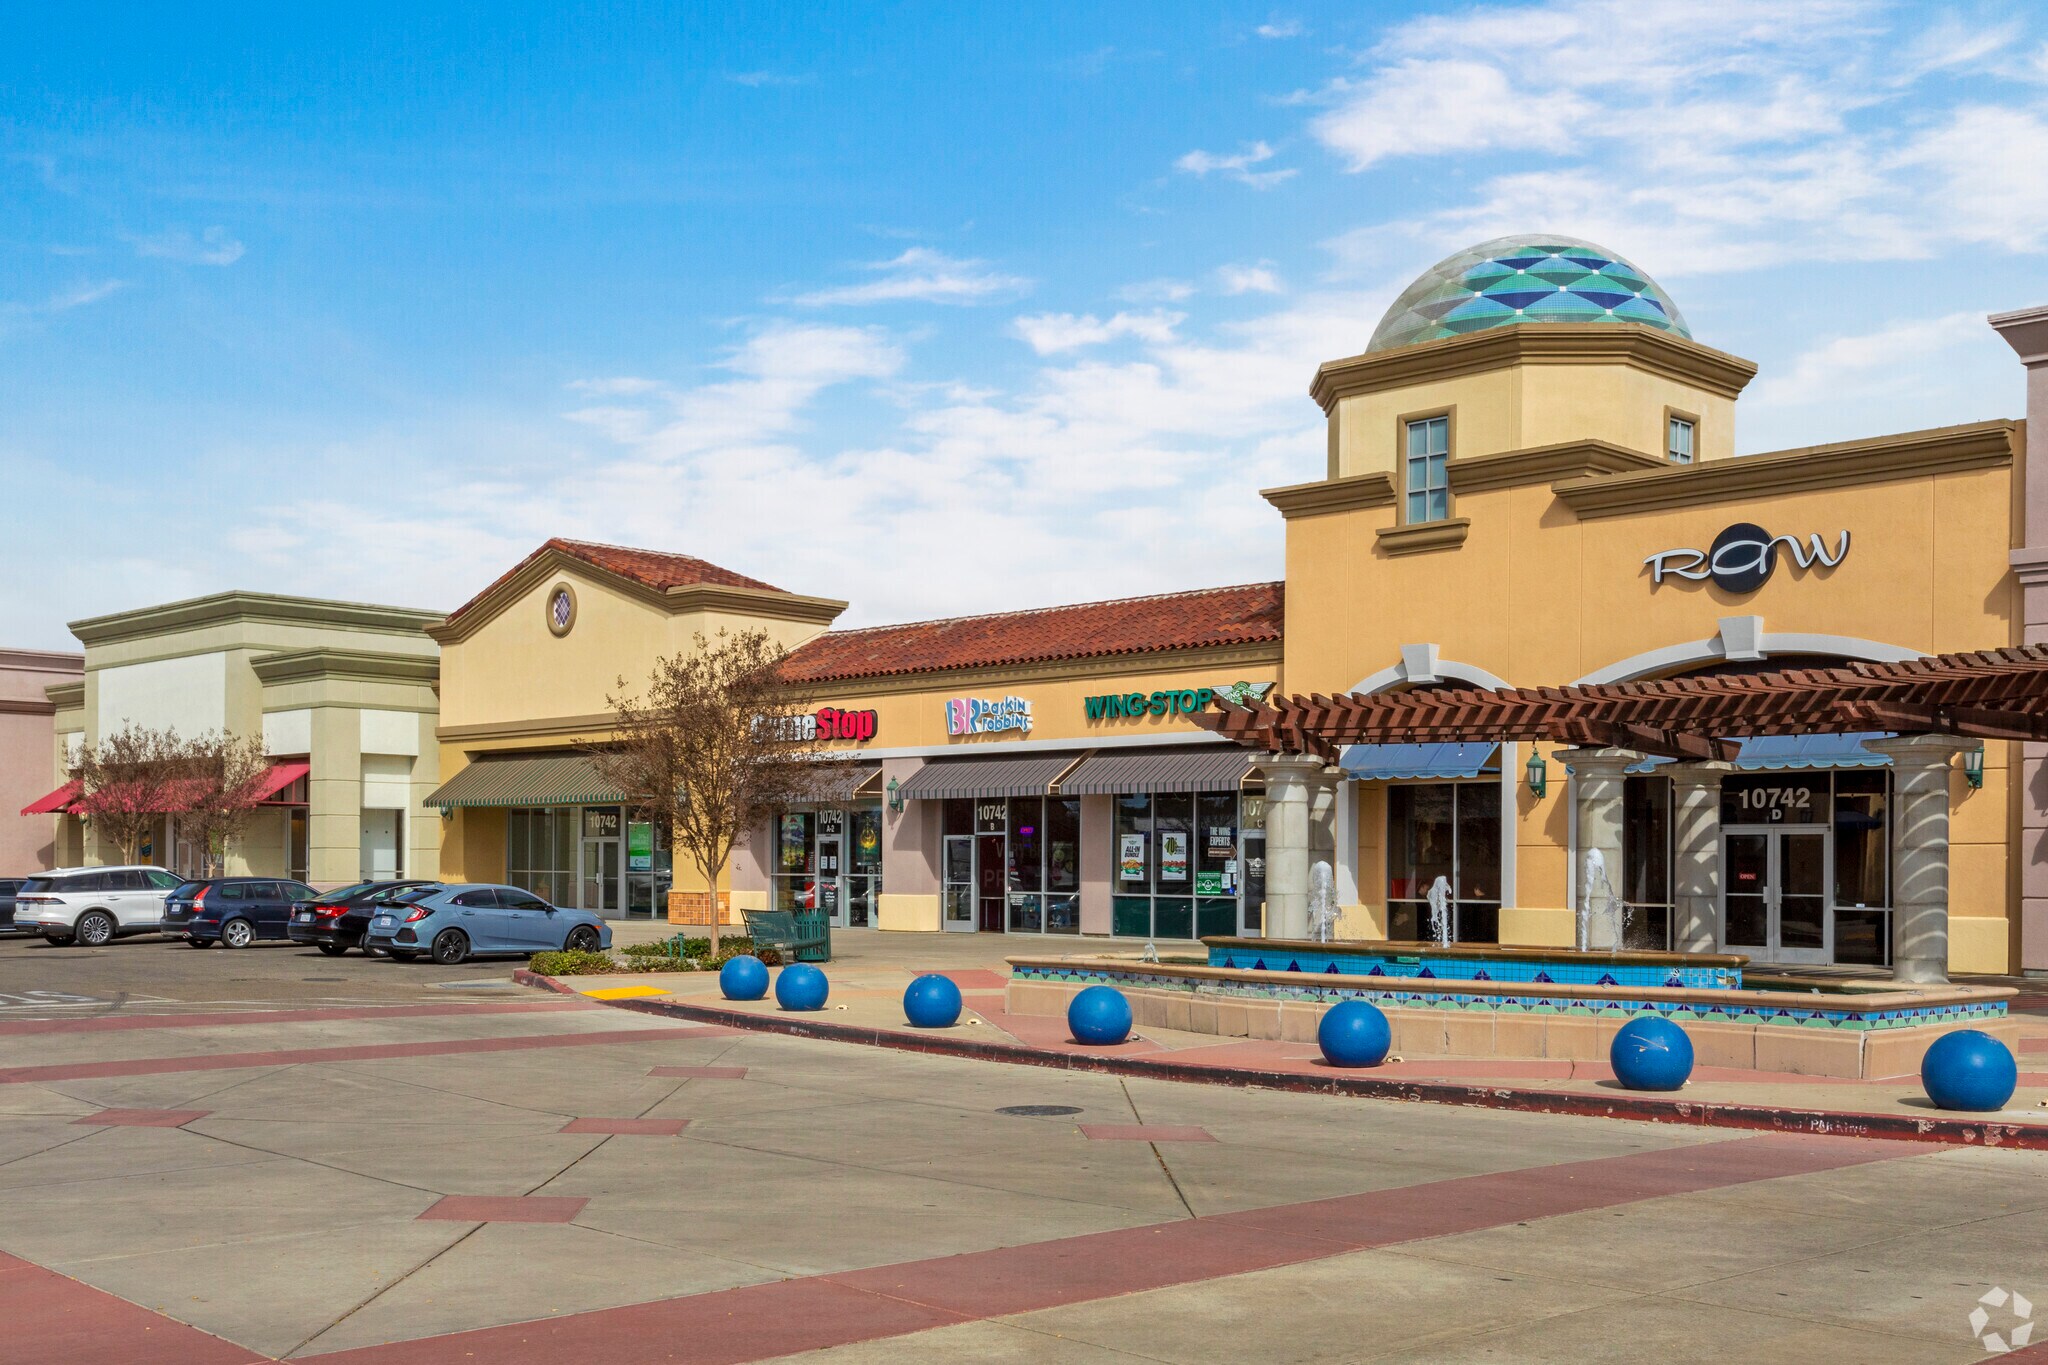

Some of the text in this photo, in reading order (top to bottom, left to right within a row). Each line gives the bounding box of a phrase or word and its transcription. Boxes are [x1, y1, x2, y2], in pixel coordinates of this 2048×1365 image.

[1739, 787, 1811, 809] 10742
[819, 809, 843, 824] 10742
[978, 805, 1006, 820] 10742
[1772, 809, 1782, 820] D
[591, 815, 617, 828] 10742
[990, 823, 995, 831] B
[1256, 819, 1263, 828] C
[1210, 836, 1231, 846] EXPERTS
